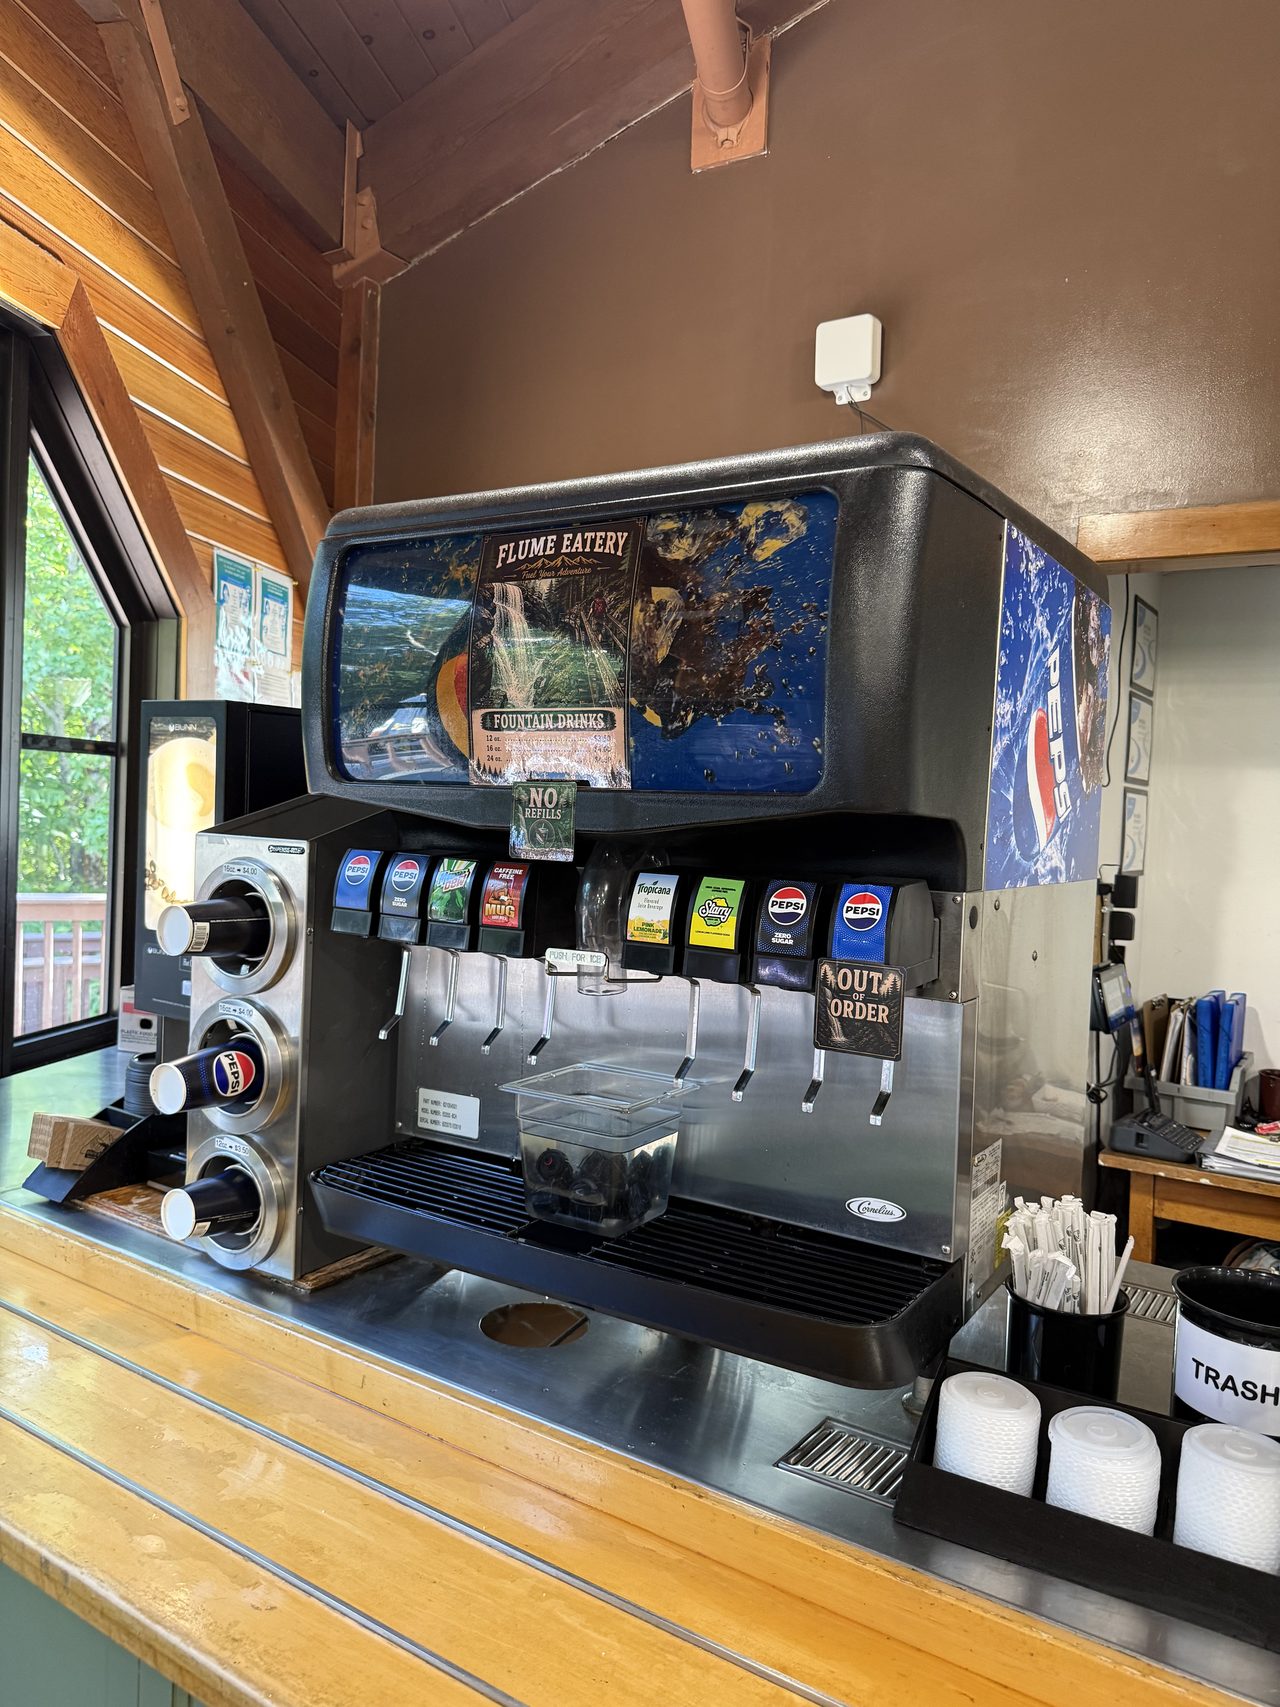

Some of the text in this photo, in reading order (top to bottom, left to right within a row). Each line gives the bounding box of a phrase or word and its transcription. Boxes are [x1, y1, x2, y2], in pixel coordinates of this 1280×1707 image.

[496, 531, 628, 569] FLUME EATERY
[522, 566, 592, 579] Fuel Your Adventure
[174, 723, 197, 731] BUNN
[494, 713, 605, 729] FOUNTAIN DRINKS
[1047, 645, 1072, 824] PEPSI
[528, 787, 558, 809] NO
[525, 808, 562, 820] REFILLS
[242, 867, 258, 876] $4.00
[347, 865, 369, 874] PEPSI
[394, 871, 418, 880] PEPSI
[494, 867, 524, 875] CAFFEINE
[637, 882, 671, 896] Tropicana
[485, 903, 516, 919] MUG
[699, 900, 732, 922] Starry
[770, 900, 804, 911] PEPSI
[845, 906, 880, 916] PEPSI
[633, 926, 663, 935] LEMONADE
[771, 937, 794, 945] SUGAR
[549, 951, 602, 964] PUSH FOR ICE
[837, 968, 883, 994] OUT
[852, 992, 866, 1001] OF
[830, 998, 889, 1024] ORDER
[224, 1053, 241, 1094] PEPSI
[858, 1200, 895, 1216] Cornelius
[1191, 1357, 1280, 1407] TRASH
